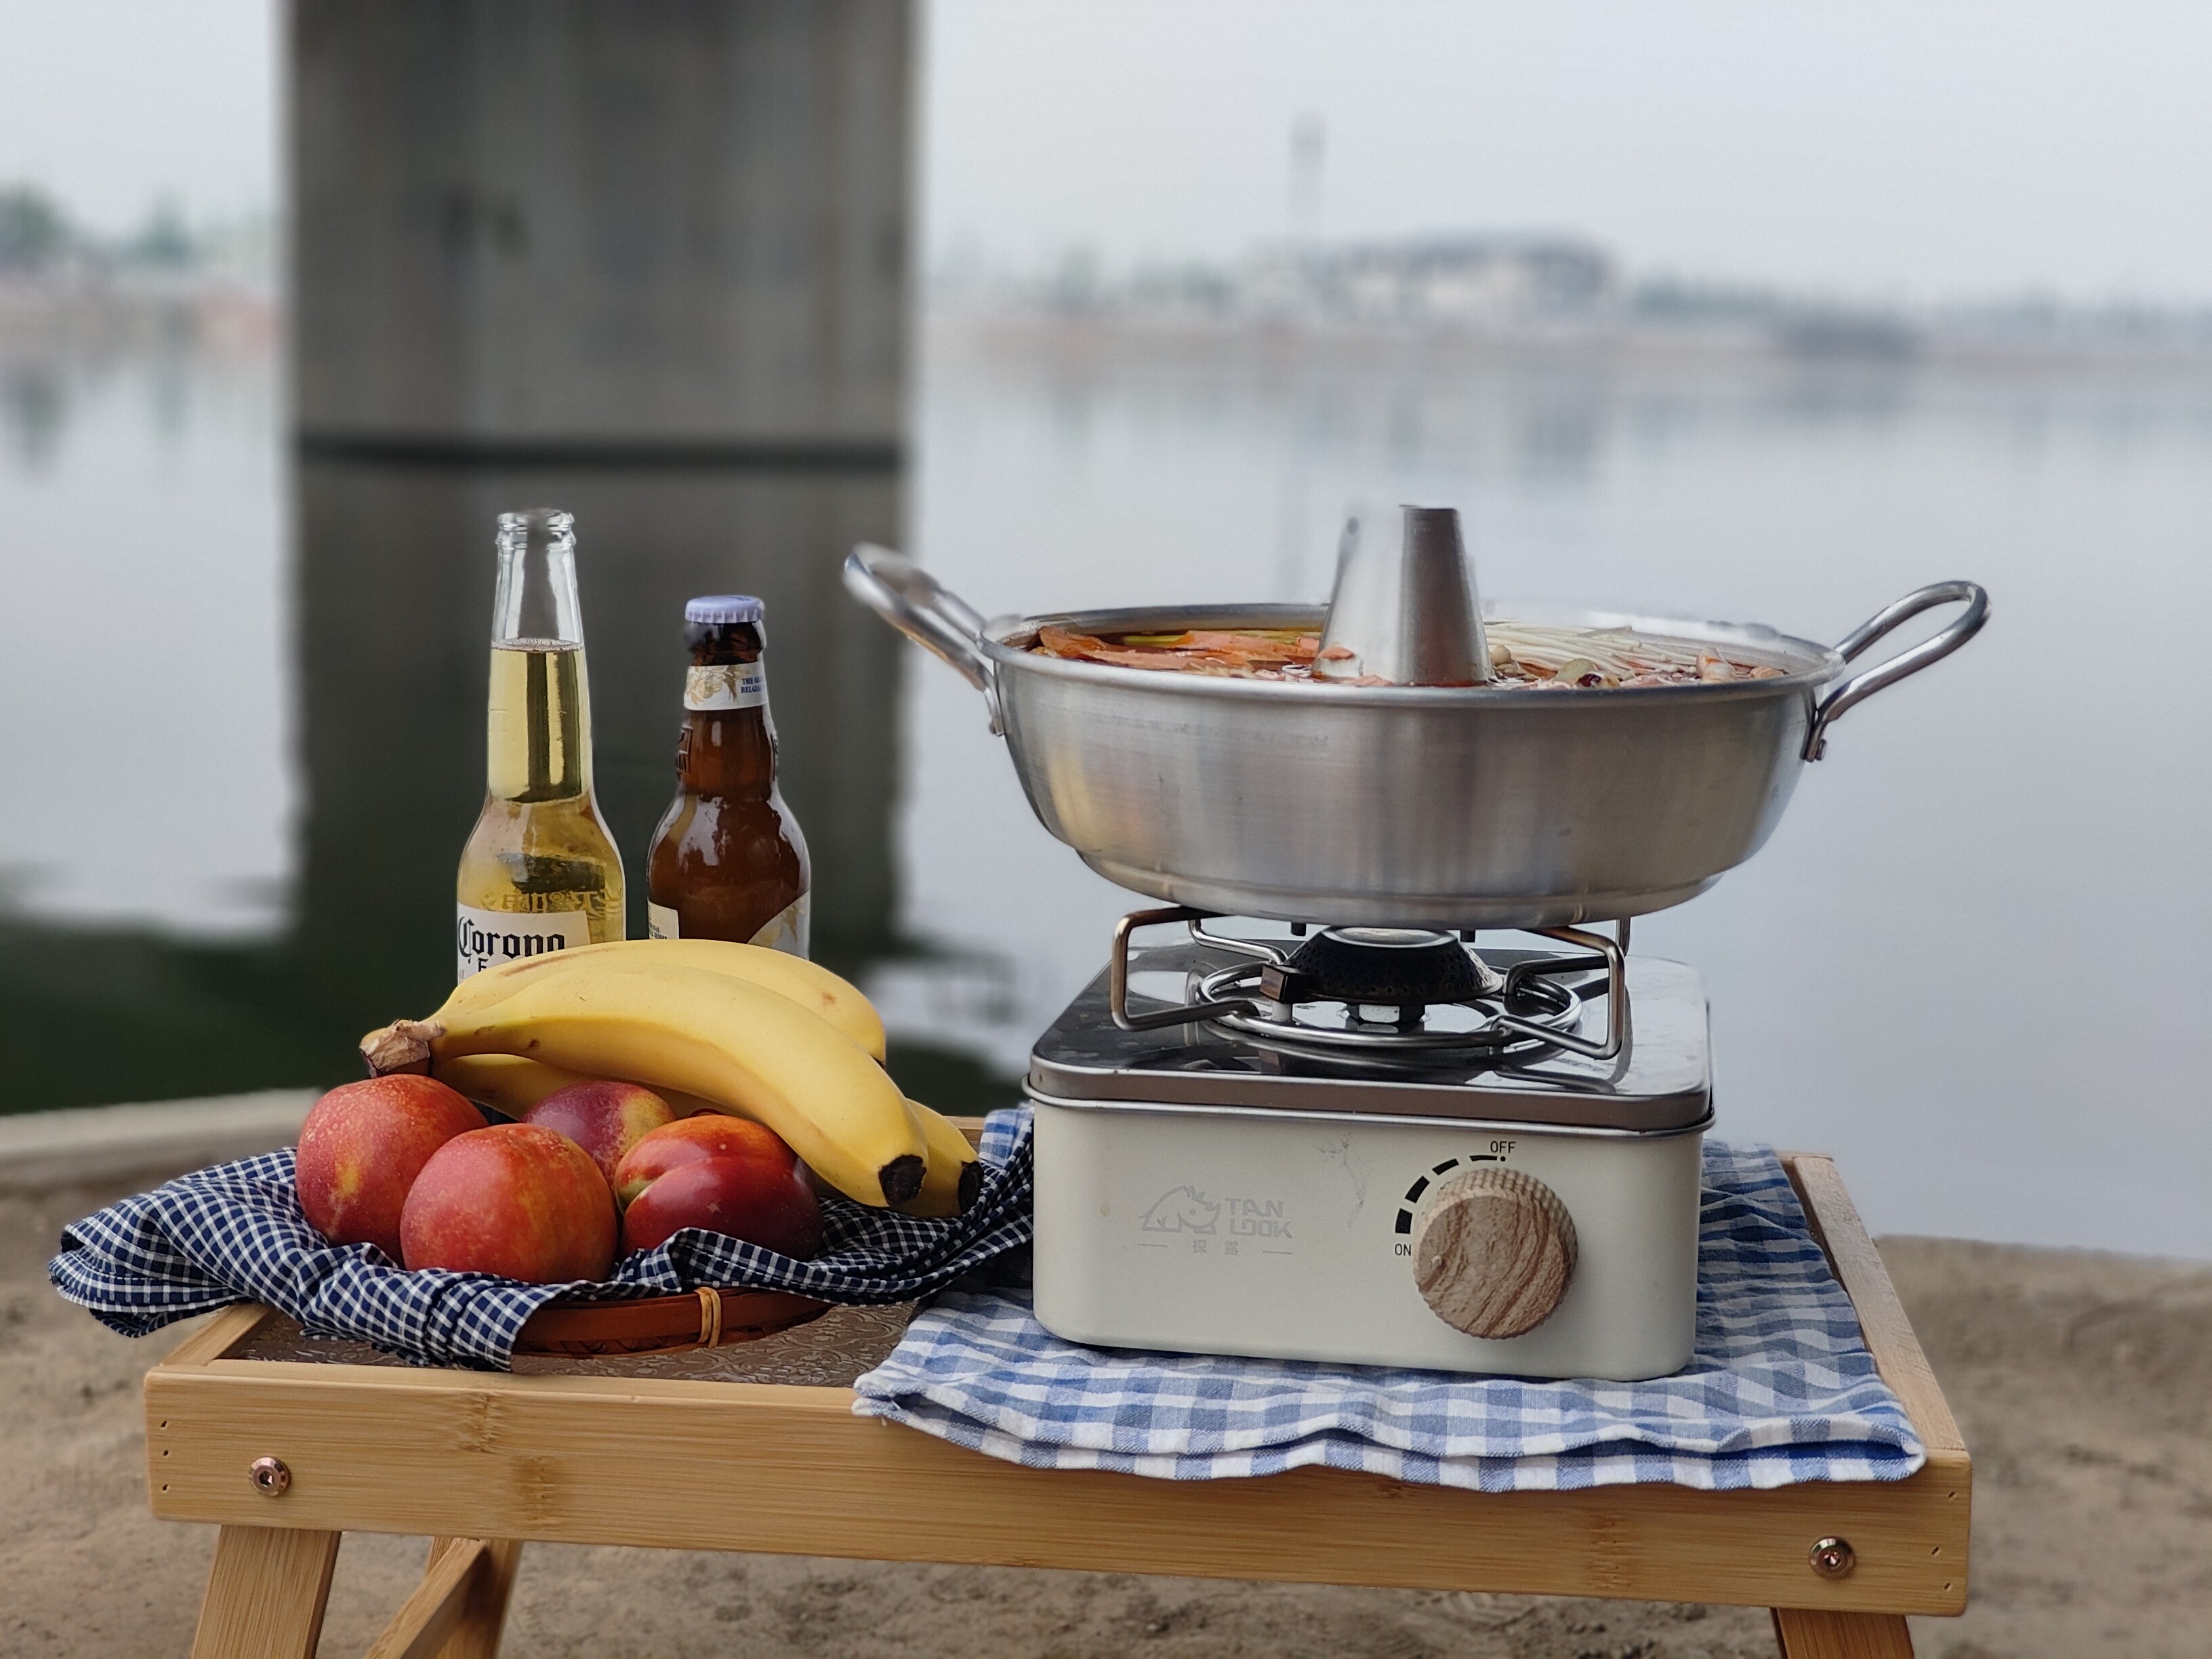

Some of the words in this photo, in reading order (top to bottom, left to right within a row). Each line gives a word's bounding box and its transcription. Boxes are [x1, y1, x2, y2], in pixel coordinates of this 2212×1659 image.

[741, 677, 754, 685] THE
[458, 916, 565, 964] Corona
[1490, 1141, 1517, 1153] OFF
[1224, 1197, 1283, 1218] TAN
[1229, 1218, 1293, 1239] LOOK
[1394, 1243, 1412, 1256] ON
